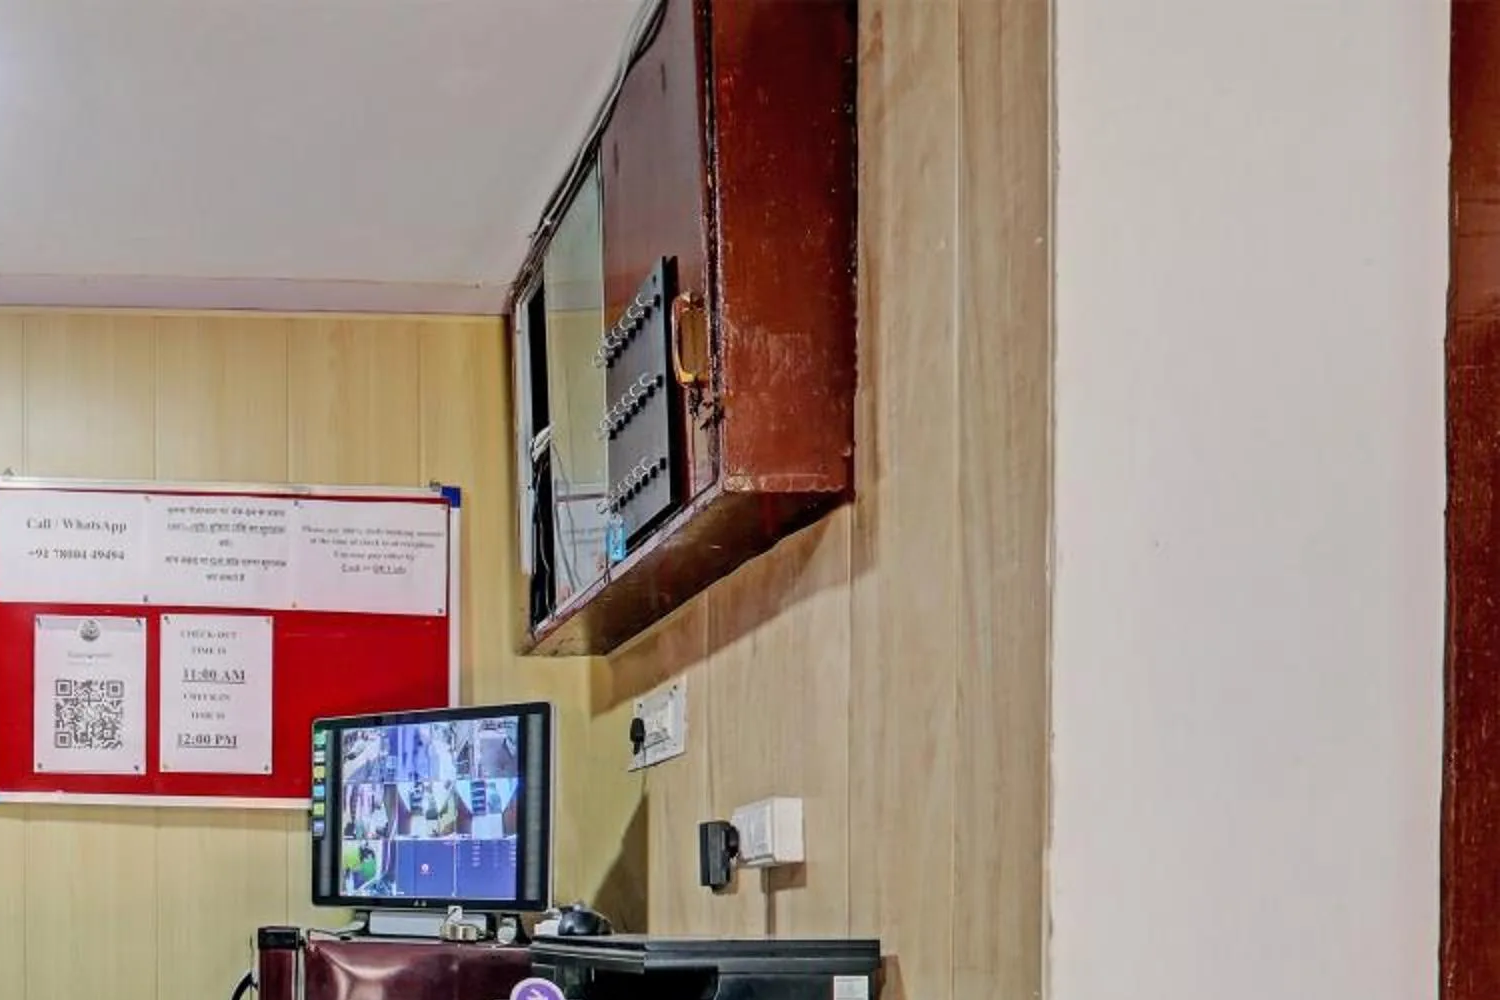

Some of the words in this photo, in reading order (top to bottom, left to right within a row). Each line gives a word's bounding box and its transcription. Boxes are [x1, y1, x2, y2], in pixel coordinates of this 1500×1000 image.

[62, 518, 127, 534] WhatsApp
[182, 668, 217, 682] 11:00
[222, 669, 246, 683] AM
[177, 732, 212, 746] 12:00
[214, 734, 238, 747] PM
